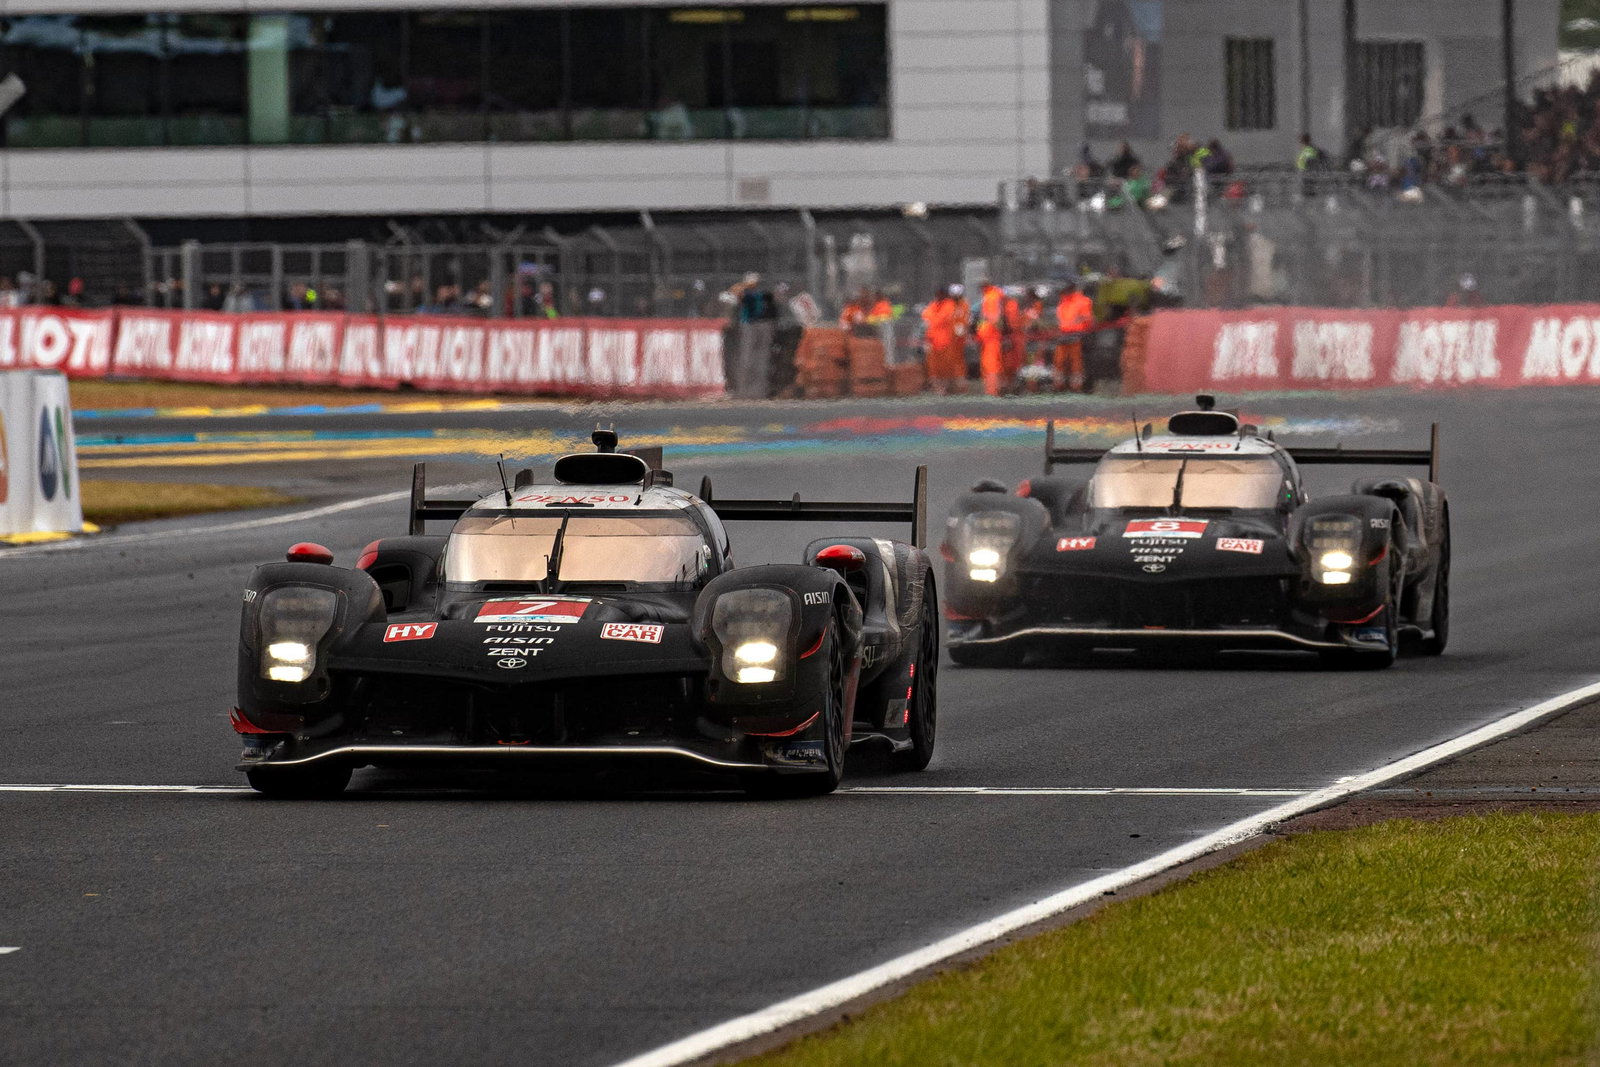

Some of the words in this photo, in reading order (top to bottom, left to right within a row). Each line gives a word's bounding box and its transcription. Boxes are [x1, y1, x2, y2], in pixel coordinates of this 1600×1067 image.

[1390, 318, 1500, 383] MOTUL
[517, 494, 629, 504] DENSO
[1150, 521, 1180, 531] 8
[1061, 538, 1092, 549] HY
[1130, 538, 1188, 546] FUJITSU
[1221, 542, 1258, 551] CAR
[1134, 555, 1177, 563] ZENT
[804, 591, 830, 605] AISIN
[514, 601, 558, 614] 7
[388, 624, 433, 639] HY
[485, 624, 561, 634] FUJITSU
[608, 624, 659, 632] HYPER
[607, 629, 657, 641] CAR
[487, 648, 544, 656] ZENT
